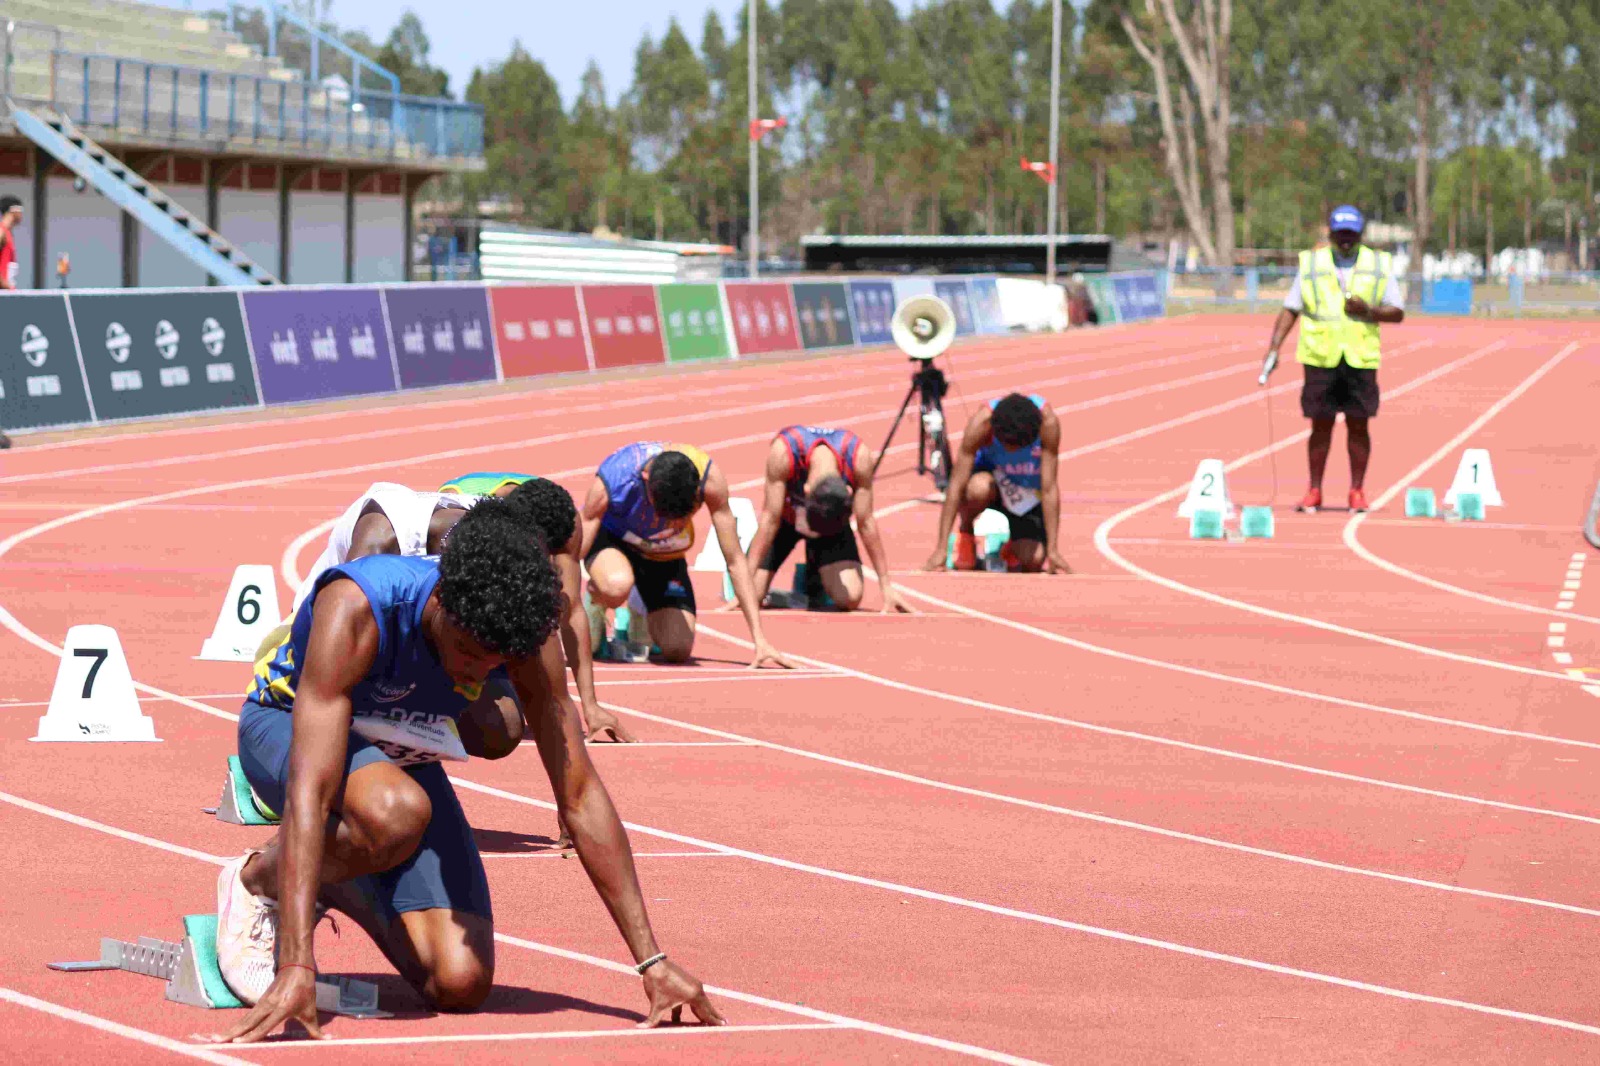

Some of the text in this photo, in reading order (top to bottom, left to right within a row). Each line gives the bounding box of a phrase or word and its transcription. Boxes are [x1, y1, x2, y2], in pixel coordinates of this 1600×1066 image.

[1200, 473, 1214, 496] 2
[1471, 463, 1478, 484] 1
[237, 584, 262, 625] 6
[73, 648, 108, 698] 7
[408, 720, 445, 737] Juventude
